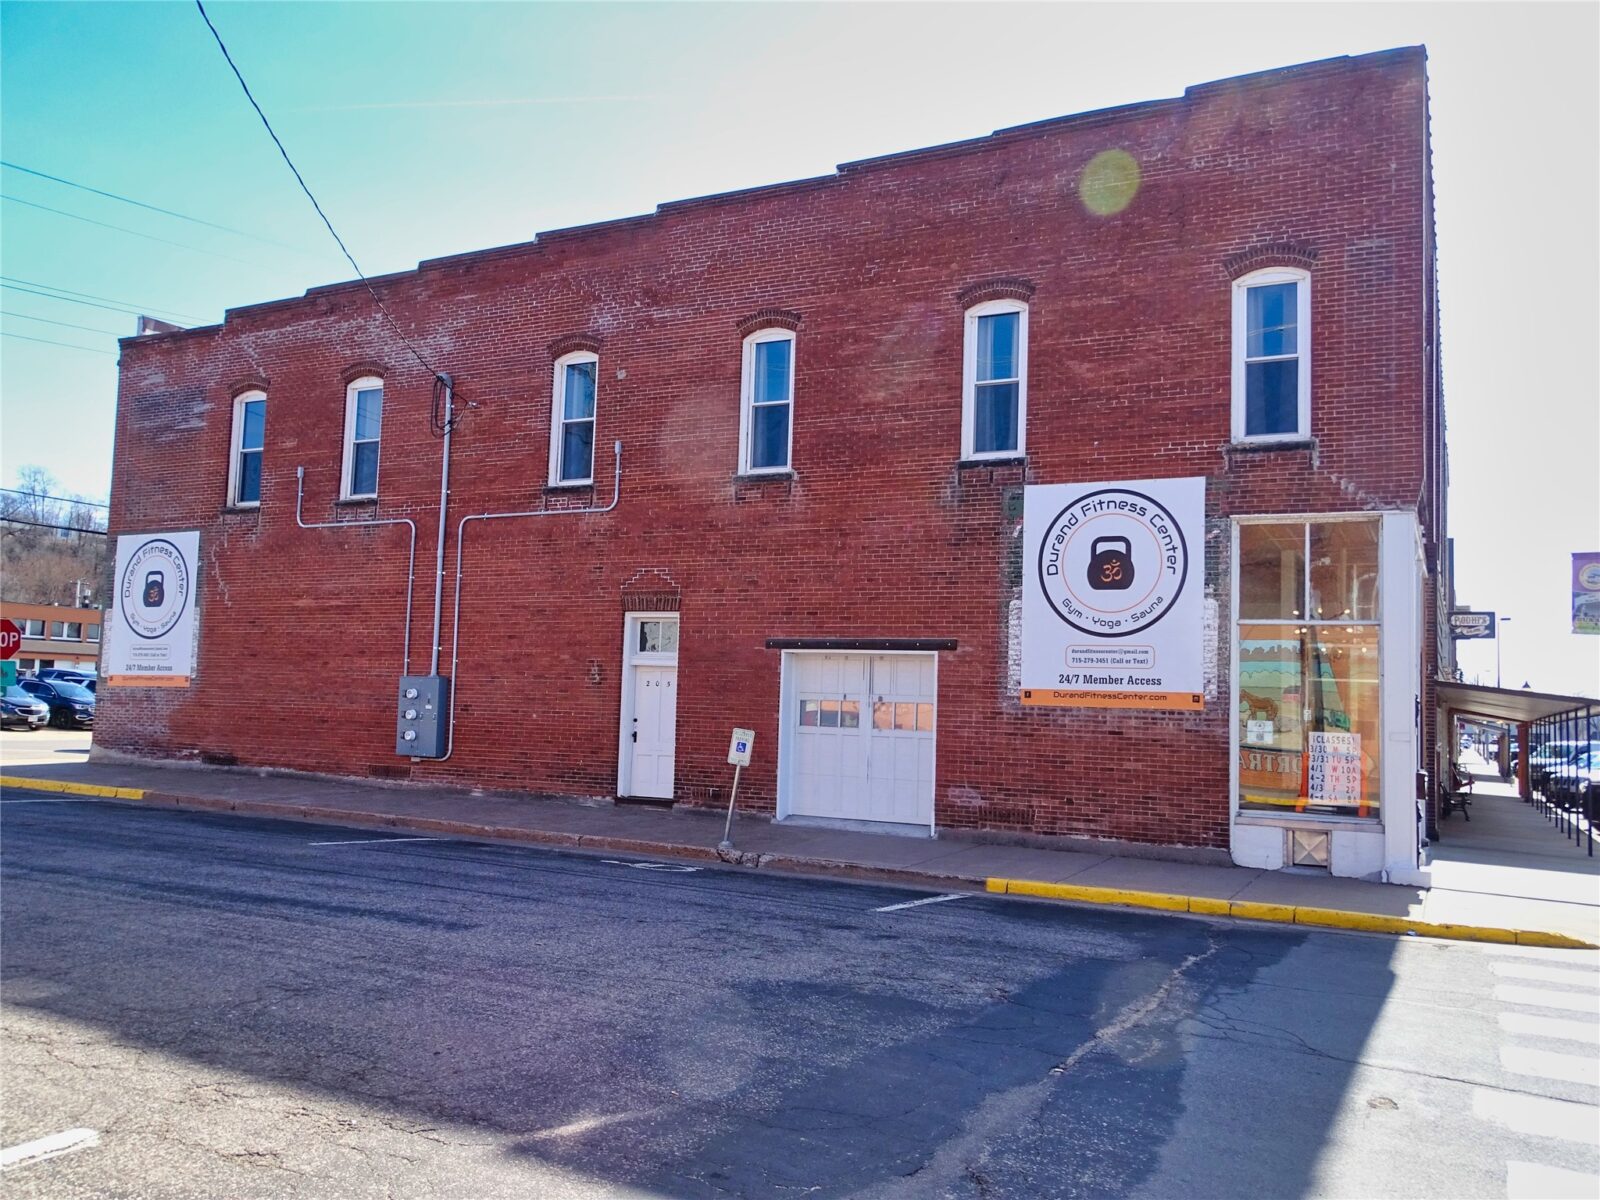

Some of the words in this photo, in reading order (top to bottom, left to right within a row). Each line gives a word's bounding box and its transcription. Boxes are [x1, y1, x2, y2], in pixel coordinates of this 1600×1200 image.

[1046, 513, 1078, 576] Durand
[1080, 499, 1147, 517] Fitness
[1149, 513, 1178, 575] Center
[124, 554, 142, 598] Durand
[142, 546, 173, 558] Fitness
[173, 555, 185, 597] Center
[1062, 598, 1083, 619] Gym
[1092, 617, 1122, 630] Yoga
[1130, 596, 1164, 622] Sauna
[1110, 657, 1124, 665] (Call
[1058, 674, 1080, 685] 24/7
[1082, 674, 1125, 685] Member
[1127, 675, 1163, 686] Access
[1053, 691, 1168, 701] DurandFitnessCenter.com
[1312, 754, 1329, 764] 3/31
[1344, 756, 1355, 764] 5P
[1310, 764, 1324, 772] 4/1
[1310, 774, 1325, 783] 4-2
[1346, 775, 1357, 784] 5P
[1310, 783, 1324, 792] 4/3
